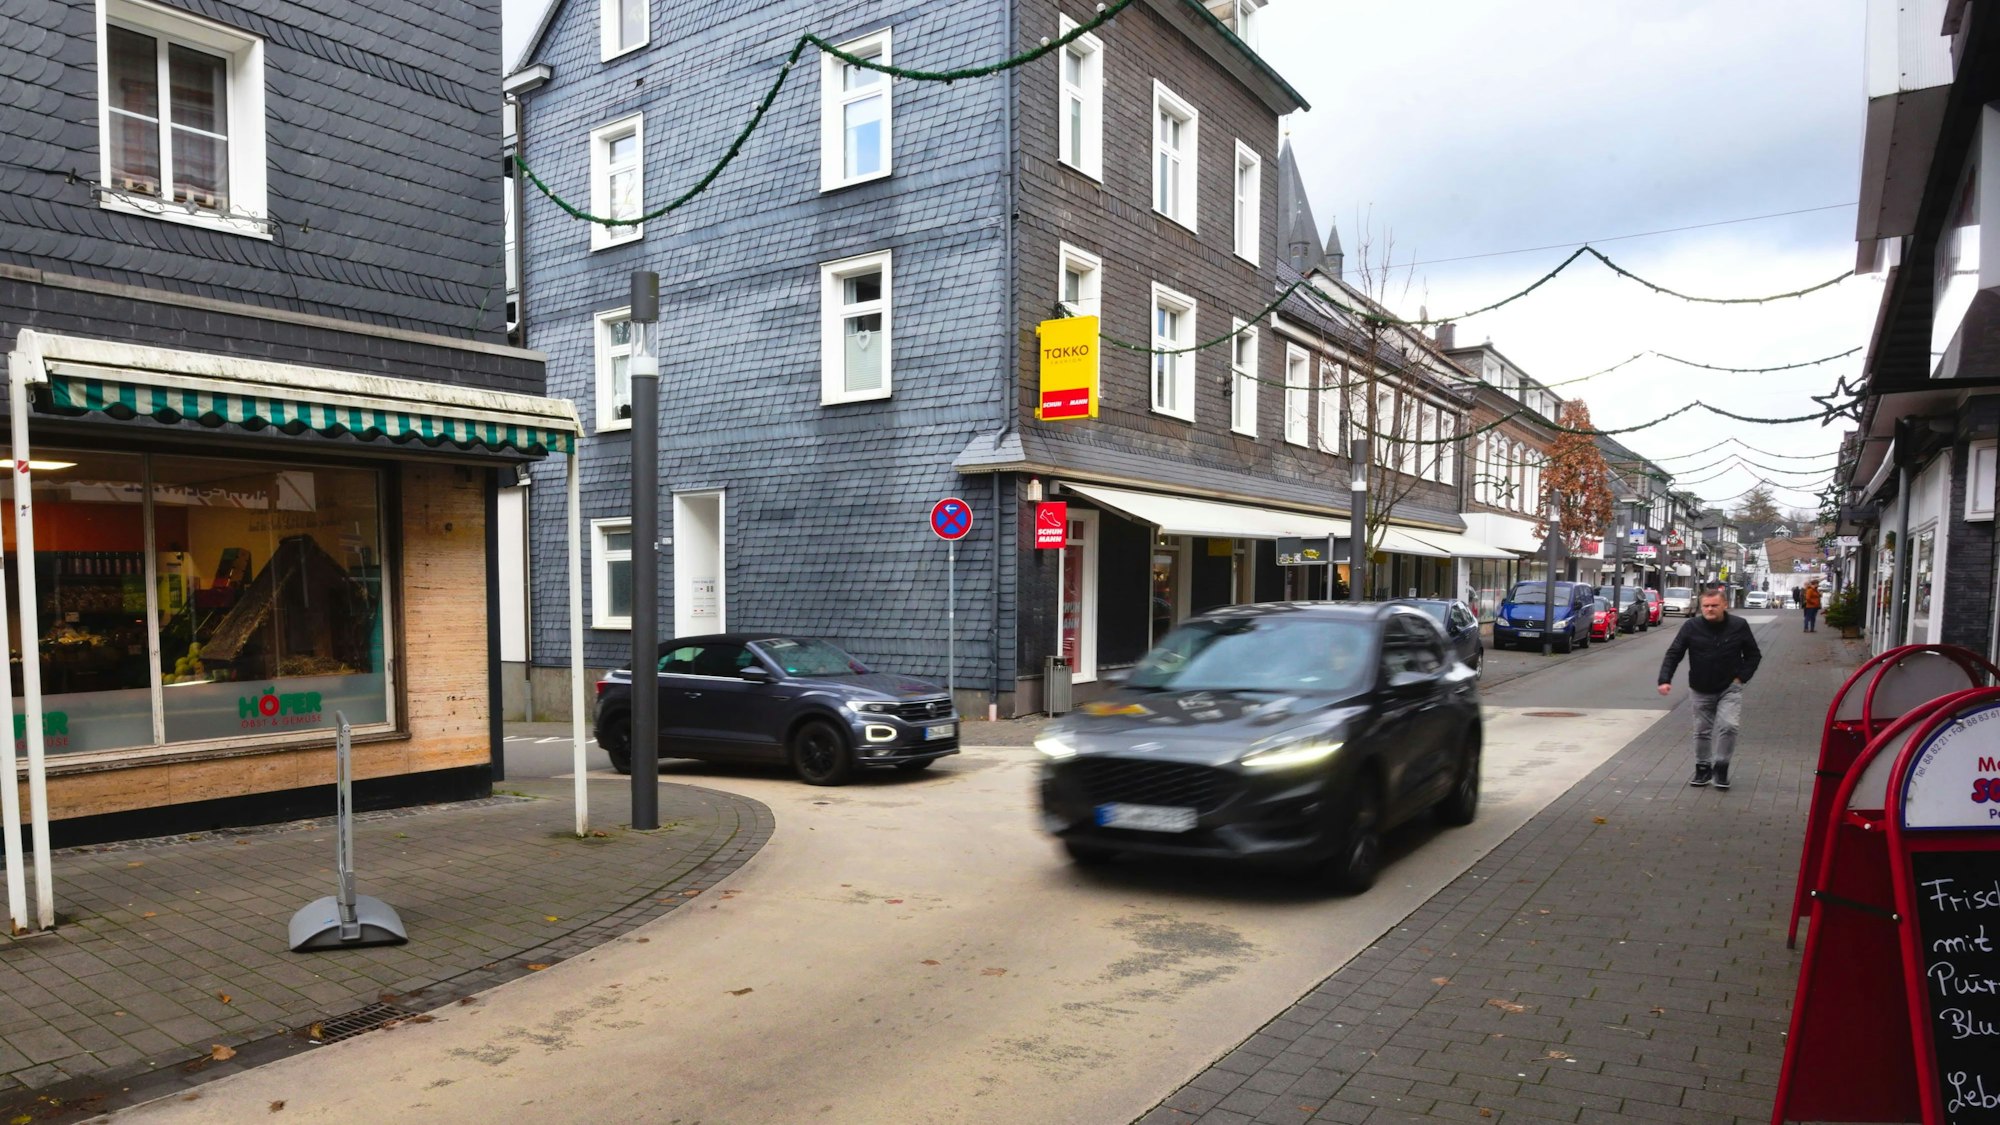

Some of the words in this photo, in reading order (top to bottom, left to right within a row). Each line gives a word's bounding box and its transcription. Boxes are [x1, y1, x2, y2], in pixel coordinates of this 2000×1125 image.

[1043, 401, 1063, 409] SCHUH
[1037, 528, 1064, 536] SCHUH
[1038, 535, 1063, 543] MANN
[1923, 754, 1934, 765] 88
[1931, 743, 1942, 755] 82
[1966, 717, 1978, 728] 88
[1978, 712, 1990, 722] 83
[1933, 925, 1993, 953] mit
[1927, 961, 2000, 996] Pür
[1947, 1071, 2000, 1113] Leb
